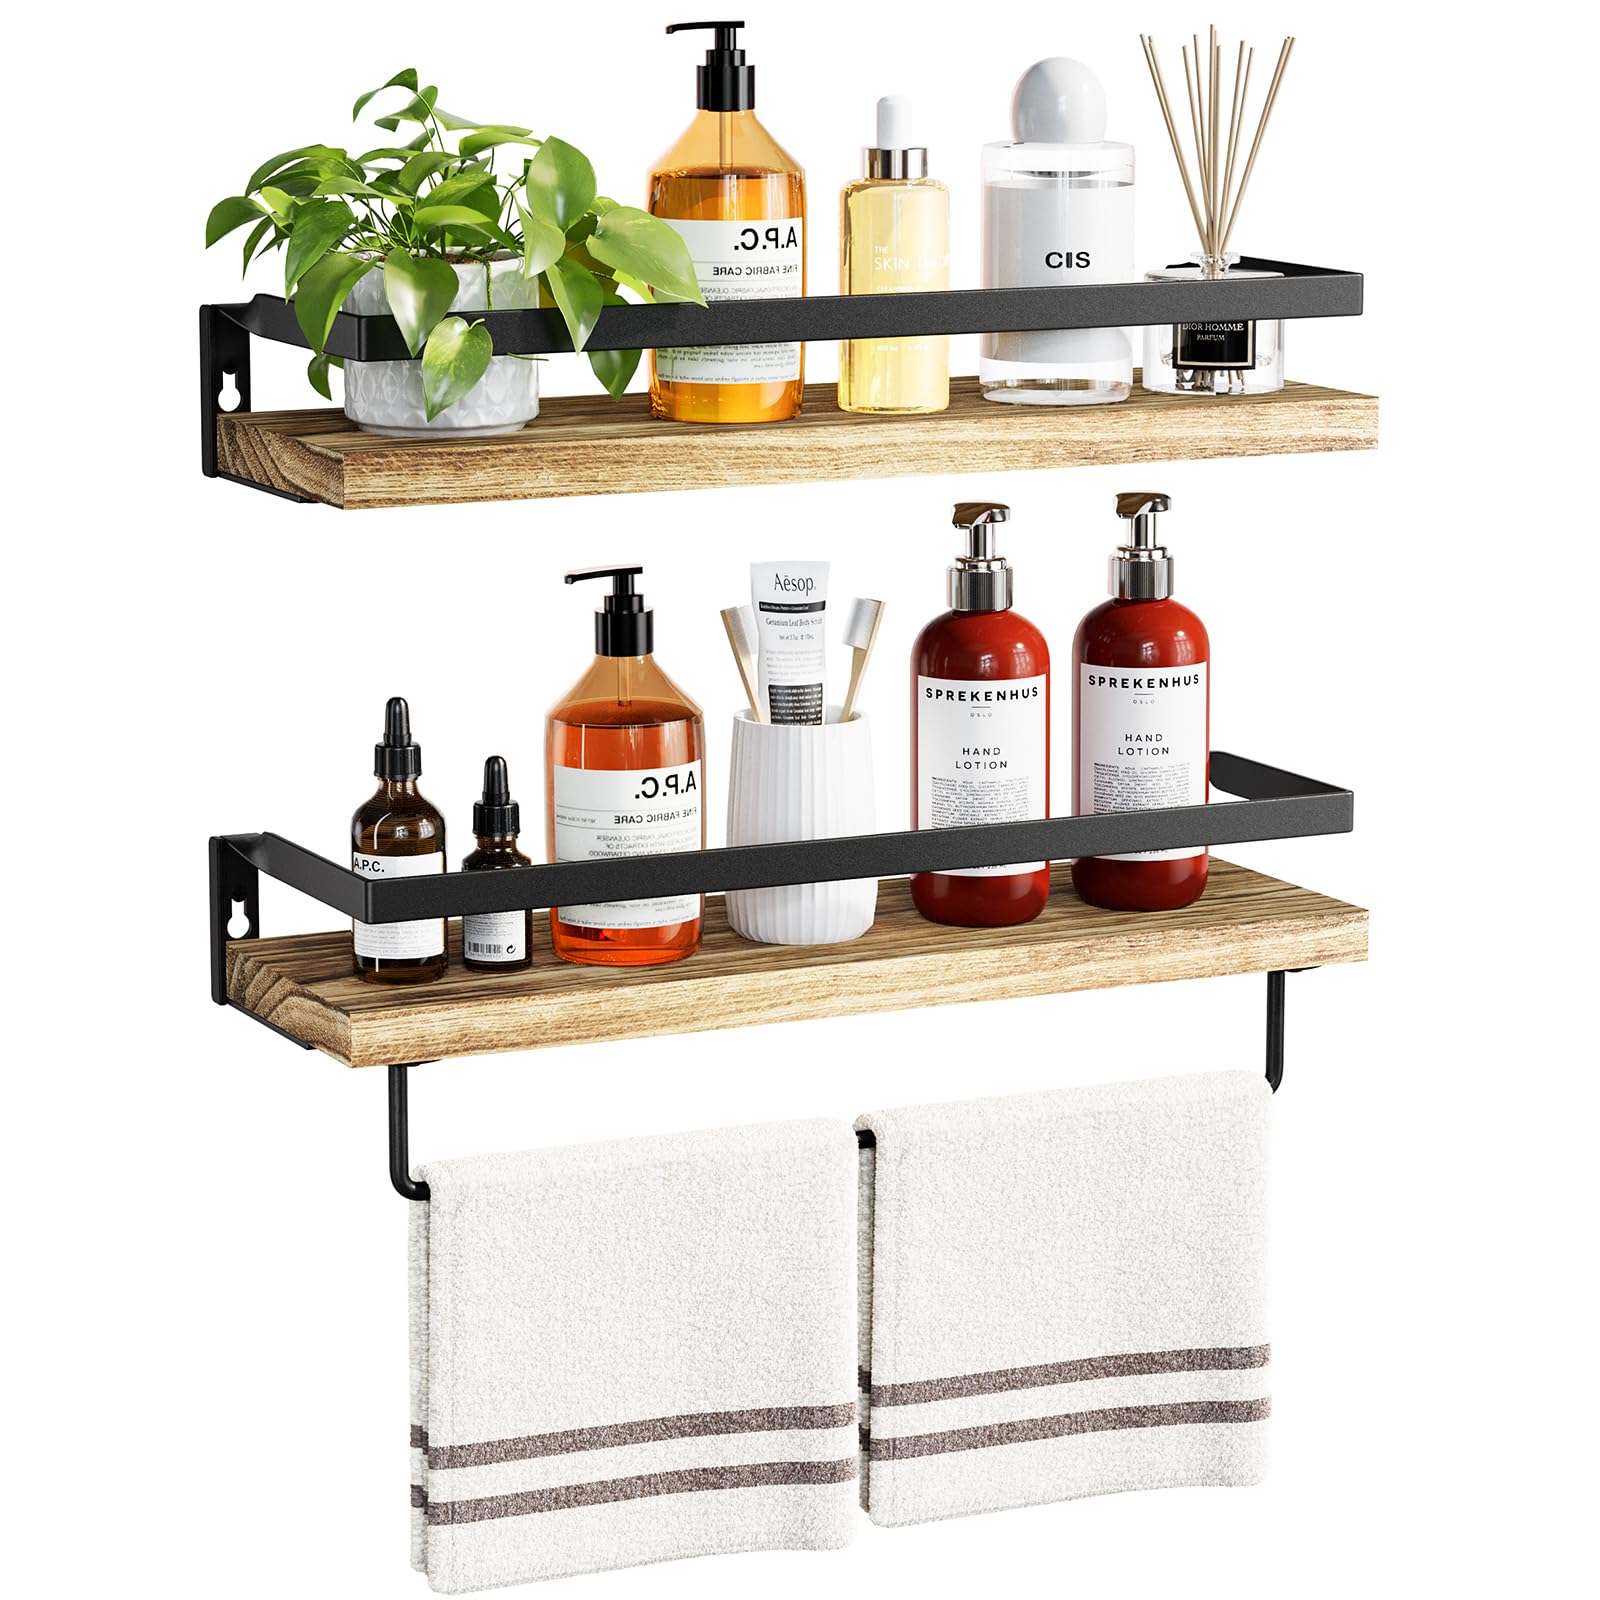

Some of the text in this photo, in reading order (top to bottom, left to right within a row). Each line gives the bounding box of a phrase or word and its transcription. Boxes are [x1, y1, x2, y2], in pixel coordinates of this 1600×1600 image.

[874, 256, 911, 271] SKIN
[1182, 322, 1245, 331] DIOR HOMME
[1088, 674, 1199, 689] SPREKENHUS
[926, 686, 1038, 702] SPREKENHUS
[1125, 733, 1163, 742] HAND
[962, 747, 1001, 756] HAND
[1118, 747, 1170, 756] LOTION
[955, 761, 1008, 770] LOTION
[354, 857, 385, 873] A.P.C.
